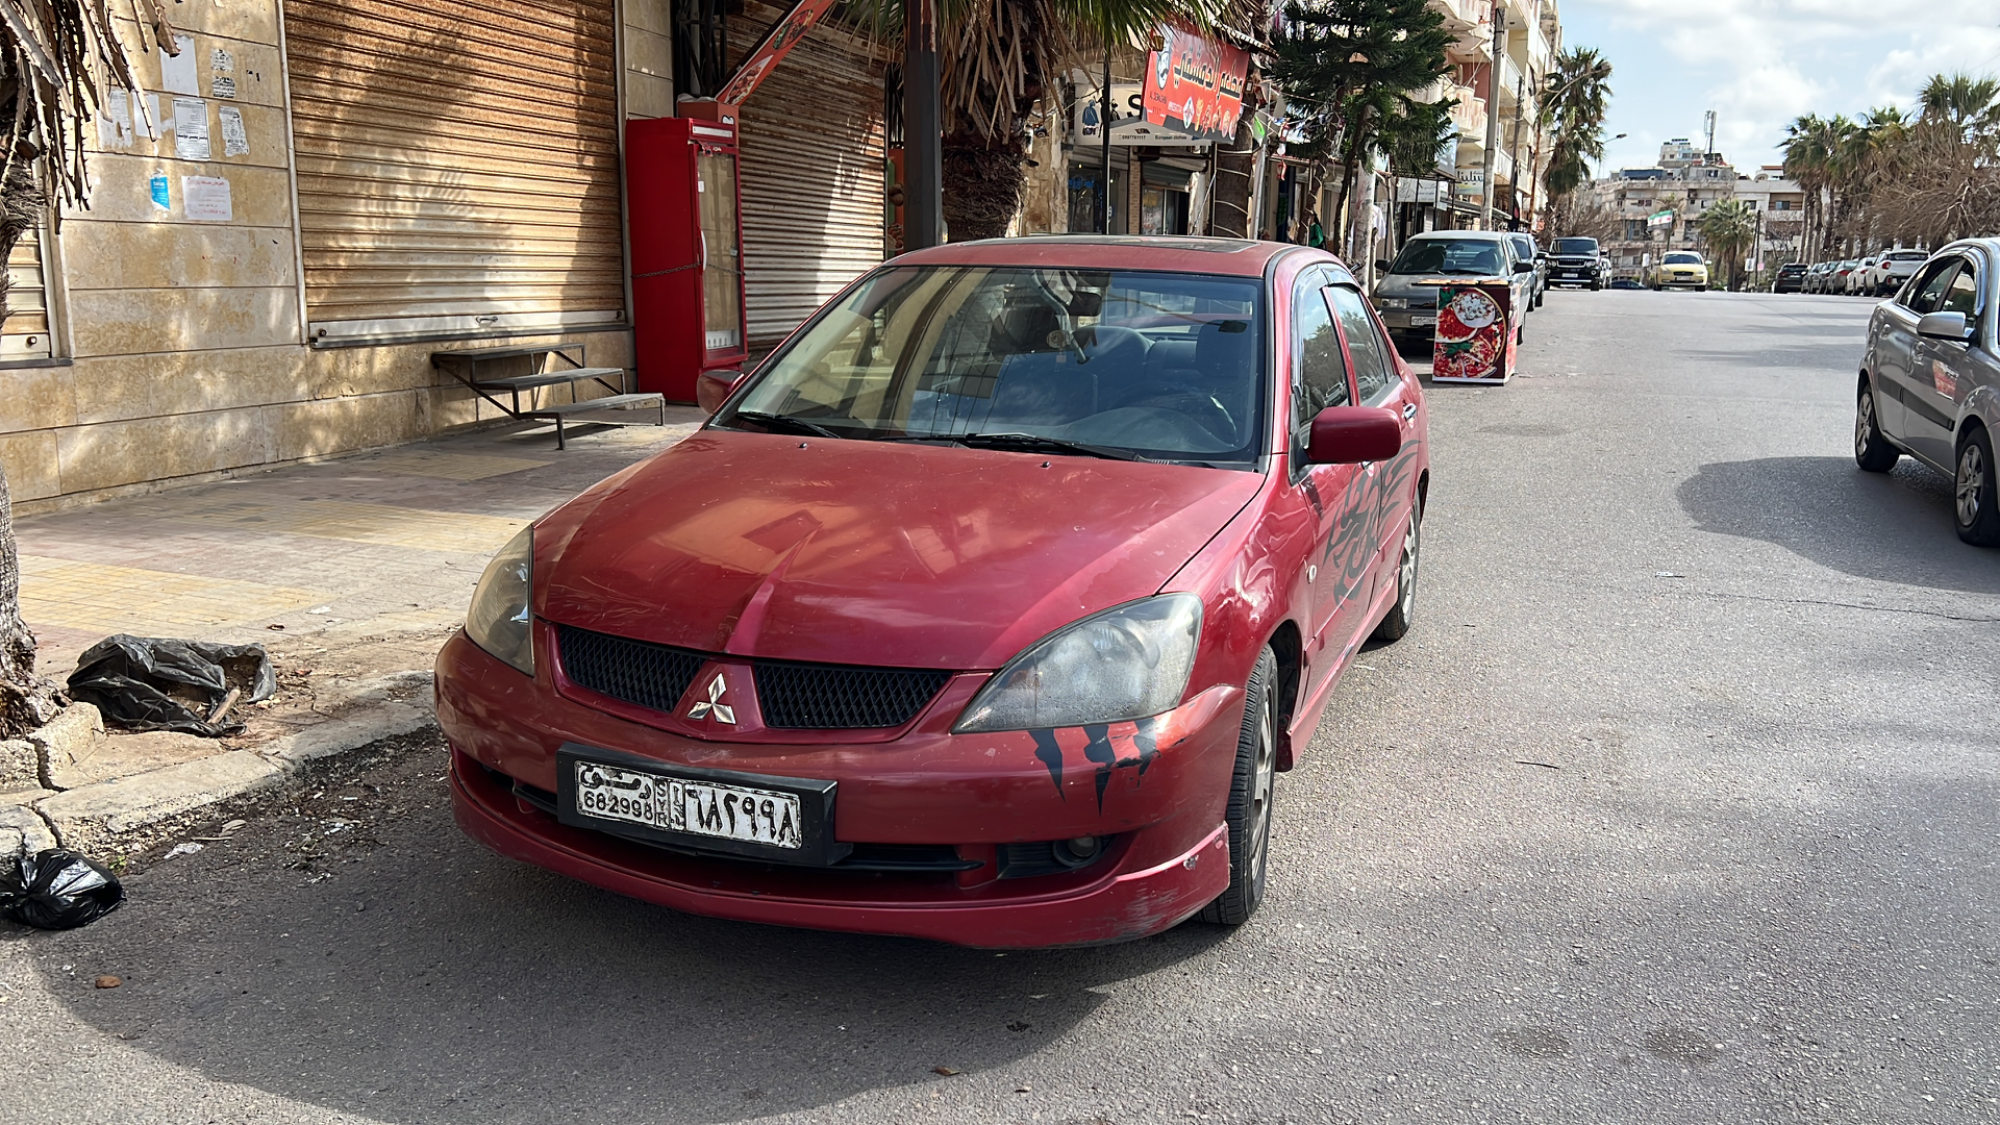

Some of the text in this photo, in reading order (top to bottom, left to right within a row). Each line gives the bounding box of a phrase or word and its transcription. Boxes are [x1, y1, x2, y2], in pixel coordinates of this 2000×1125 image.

[1173, 46, 1244, 100] مطعم الدمشقي
[584, 791, 654, 821] 682998
[686, 788, 797, 841] ٦٨٢٩٩٨
